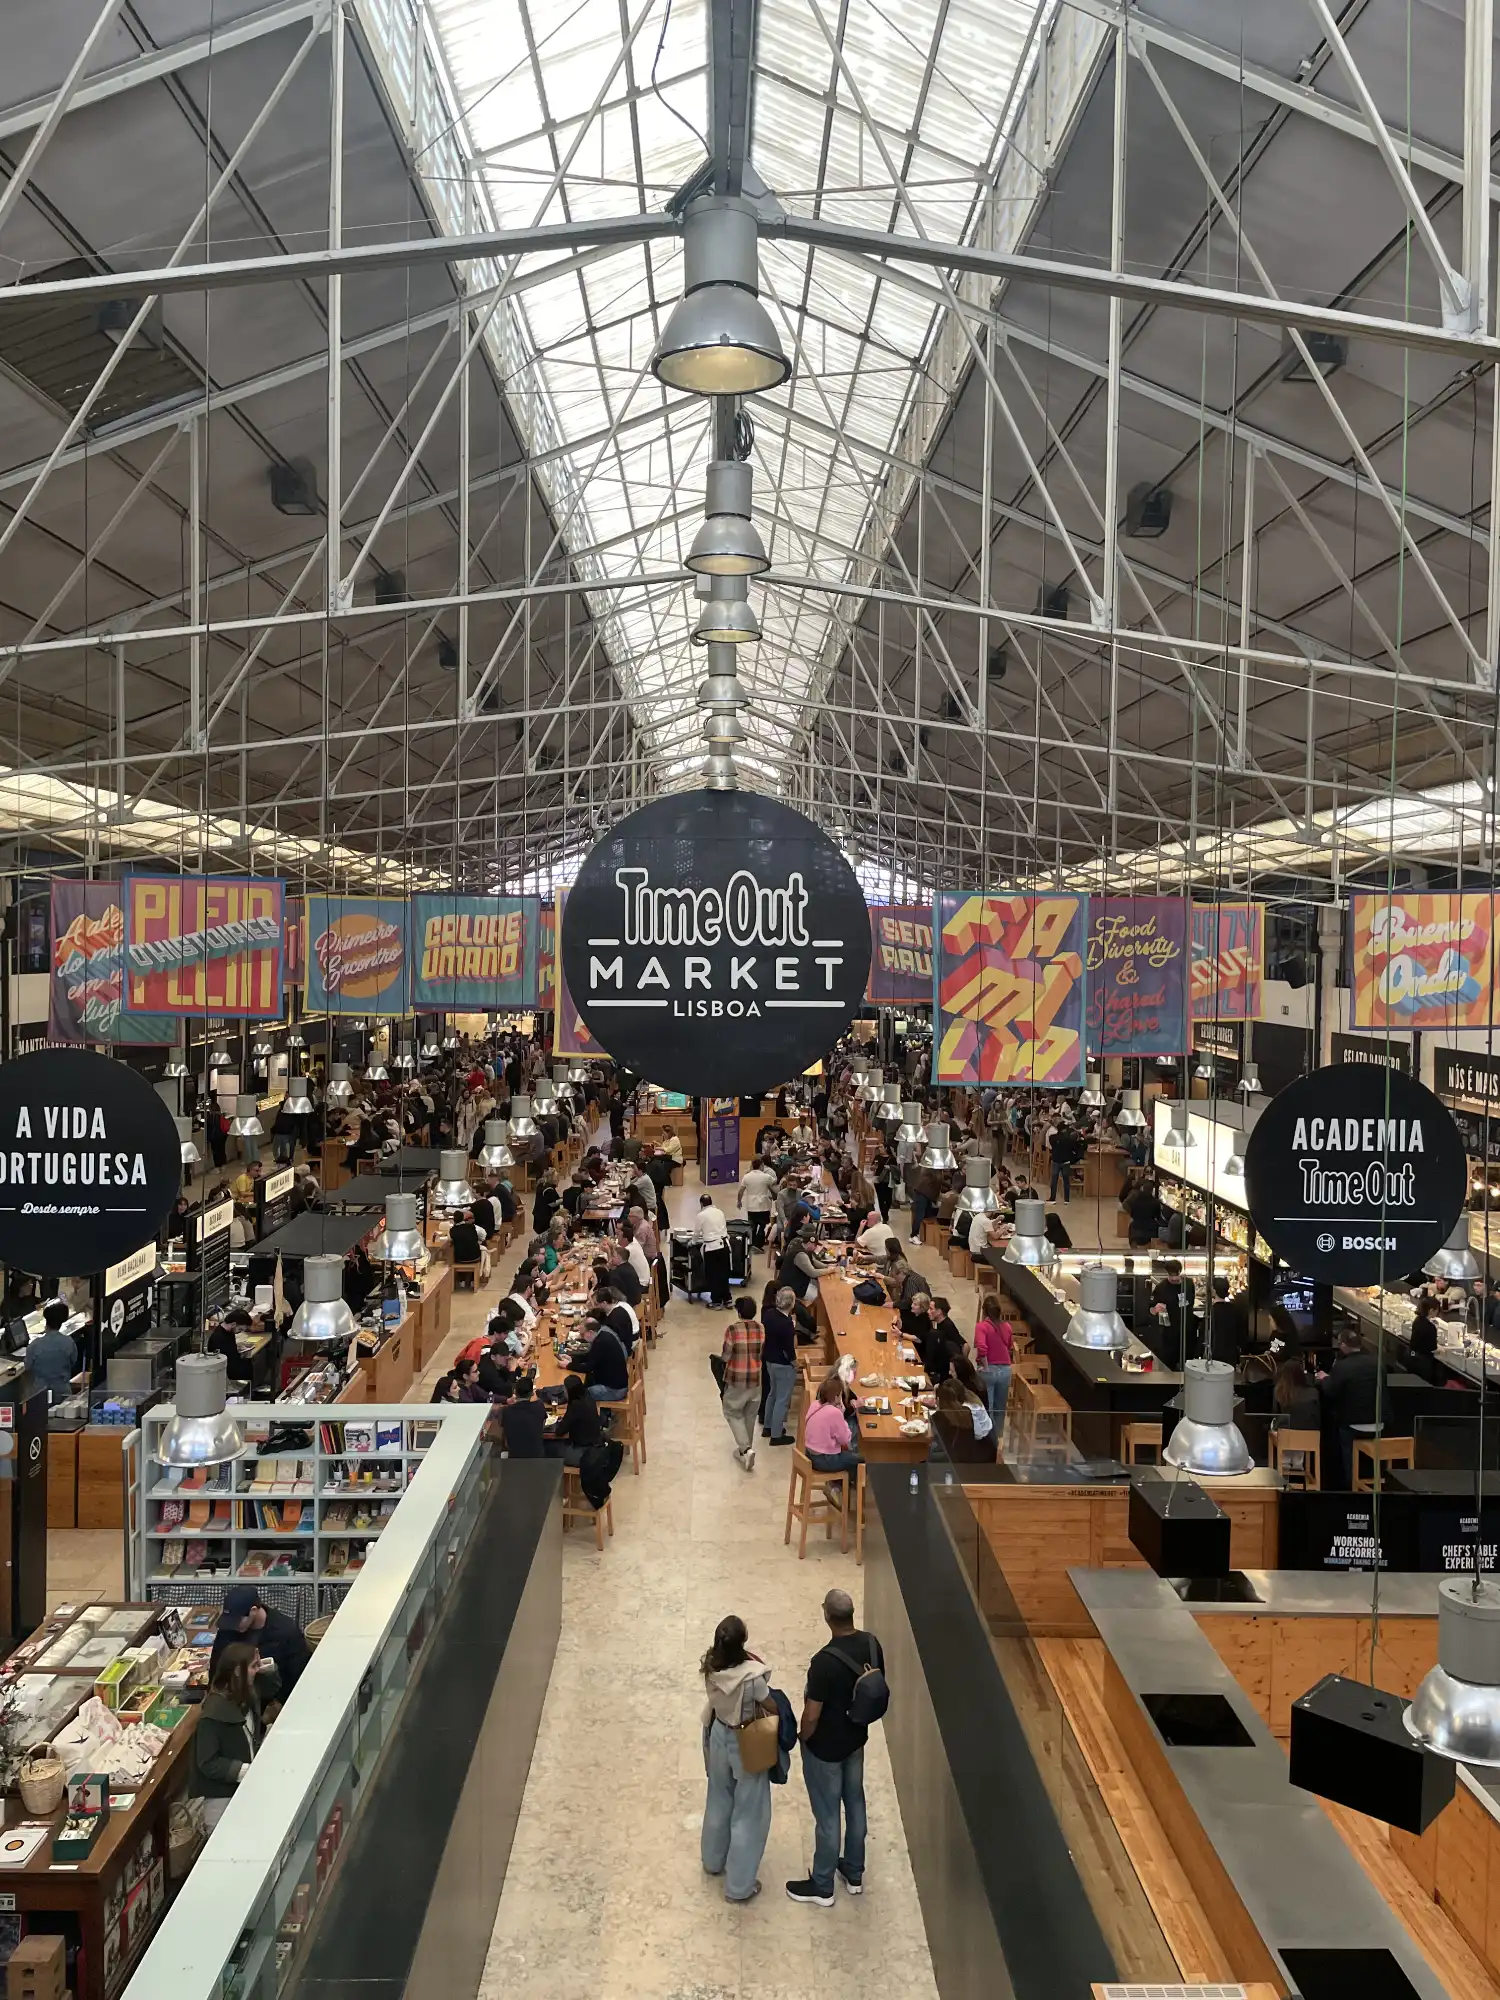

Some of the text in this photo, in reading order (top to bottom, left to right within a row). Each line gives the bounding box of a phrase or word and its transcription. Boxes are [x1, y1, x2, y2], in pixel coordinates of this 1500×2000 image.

[616, 868, 809, 946] Time Out
[315, 924, 397, 962] Primeiro
[424, 910, 523, 949] CALORE
[880, 917, 932, 949] SEN
[1096, 915, 1157, 946] Food
[322, 943, 402, 992] Encontro
[421, 942, 519, 981] UMANO
[1086, 935, 1181, 971] Diversity
[1192, 946, 1260, 991] OVE
[590, 956, 843, 990] MARKET
[1115, 957, 1139, 985] &
[1379, 948, 1467, 1005] Onda
[77, 995, 123, 1033] lug
[673, 1000, 762, 1017] LISBOA
[1086, 984, 1166, 1028] Shared
[1098, 1008, 1160, 1044] Love
[1370, 1053, 1400, 1071] DAVVRO
[1448, 1063, 1498, 1097] NÓS É MAIS
[16, 1106, 106, 1139] A VIDA
[1292, 1118, 1424, 1152] ACADEMIA
[1299, 1159, 1416, 1206] Time Out
[21, 1203, 100, 1216] Desde sempre
[1342, 1236, 1397, 1251] BOSCH
[1330, 1547, 1383, 1559] A DECORRER
[1334, 1536, 1380, 1548] WORKSHO
[1442, 1544, 1498, 1557] CHEF'S TABLE
[1372, 1559, 1388, 1567] PACE
[1445, 1557, 1495, 1569] EXPERINCE
